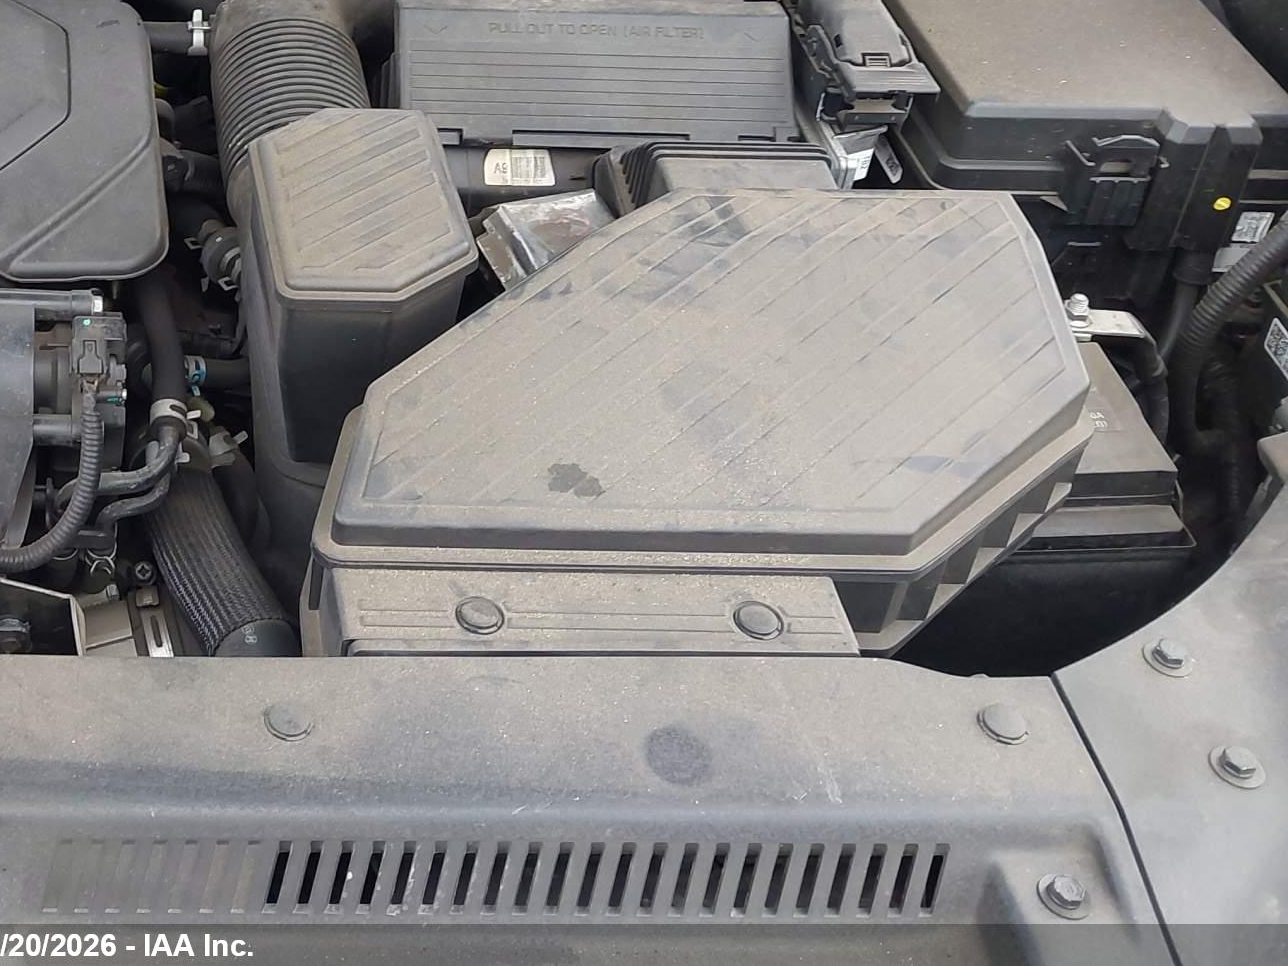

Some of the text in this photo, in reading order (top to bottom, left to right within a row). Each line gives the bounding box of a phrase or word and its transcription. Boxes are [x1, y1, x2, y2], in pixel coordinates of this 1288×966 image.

[488, 22, 524, 34] PULL
[527, 23, 554, 34] OUT
[558, 24, 575, 35] TO
[579, 24, 616, 36] OPEN
